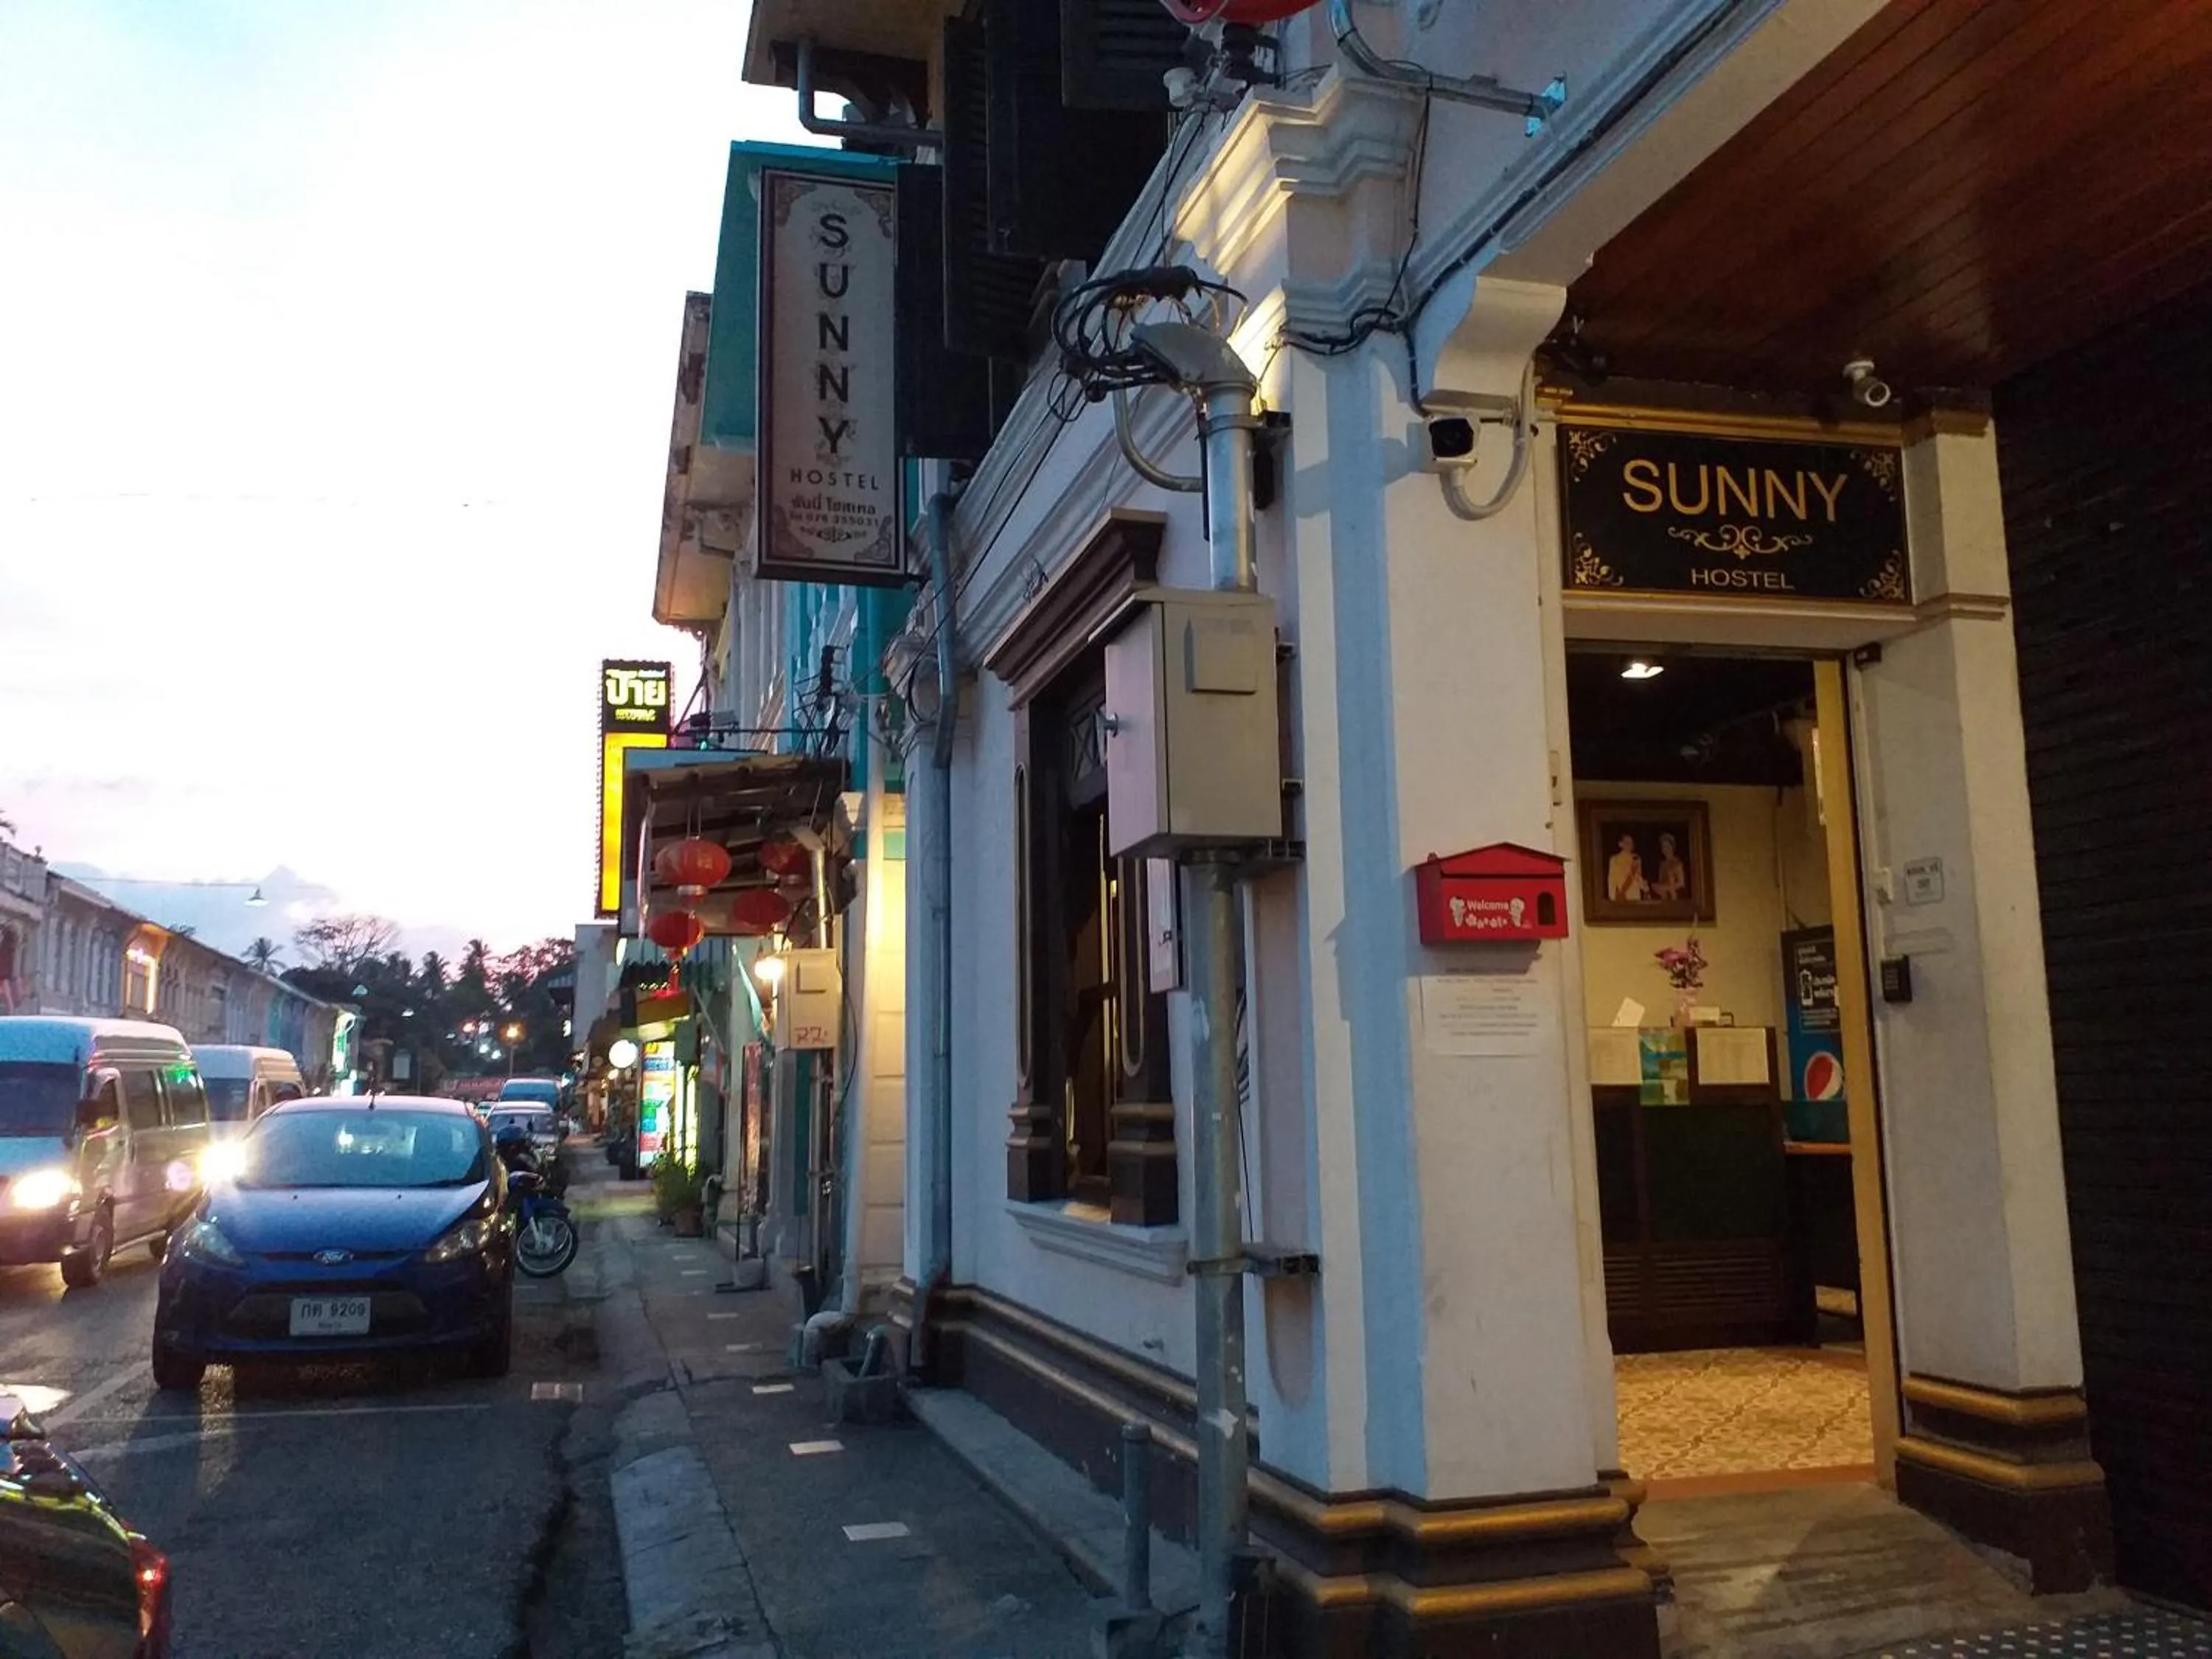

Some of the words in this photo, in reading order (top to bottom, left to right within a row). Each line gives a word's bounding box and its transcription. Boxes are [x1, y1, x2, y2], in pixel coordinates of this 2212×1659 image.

[818, 213, 849, 454] SUNNY
[790, 467, 879, 491] HOSTEL
[1624, 459, 1848, 522] SUNNY
[1691, 567, 1795, 591] HOSTEL
